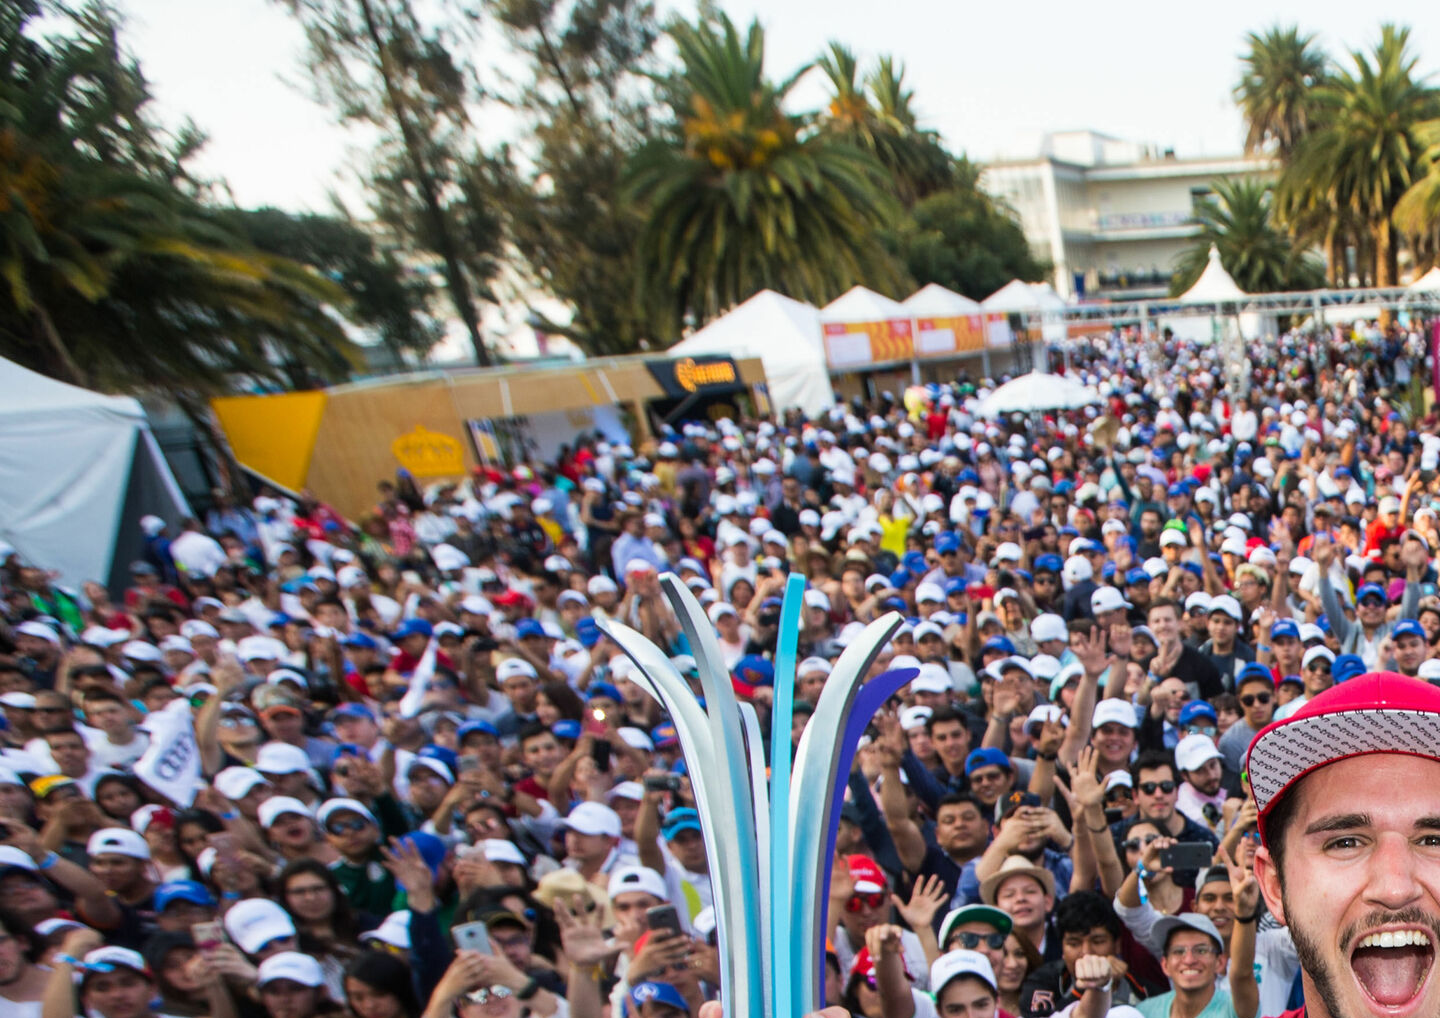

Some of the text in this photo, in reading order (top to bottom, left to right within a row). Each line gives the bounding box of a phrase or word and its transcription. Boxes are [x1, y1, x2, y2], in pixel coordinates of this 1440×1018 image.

[1292, 727, 1322, 744] e-tron
[1311, 725, 1340, 741] e-tron
[1331, 723, 1360, 739] e-tron
[1411, 722, 1436, 741] e-tron
[1269, 741, 1299, 758] e-tron
[1289, 739, 1317, 754] e-tron
